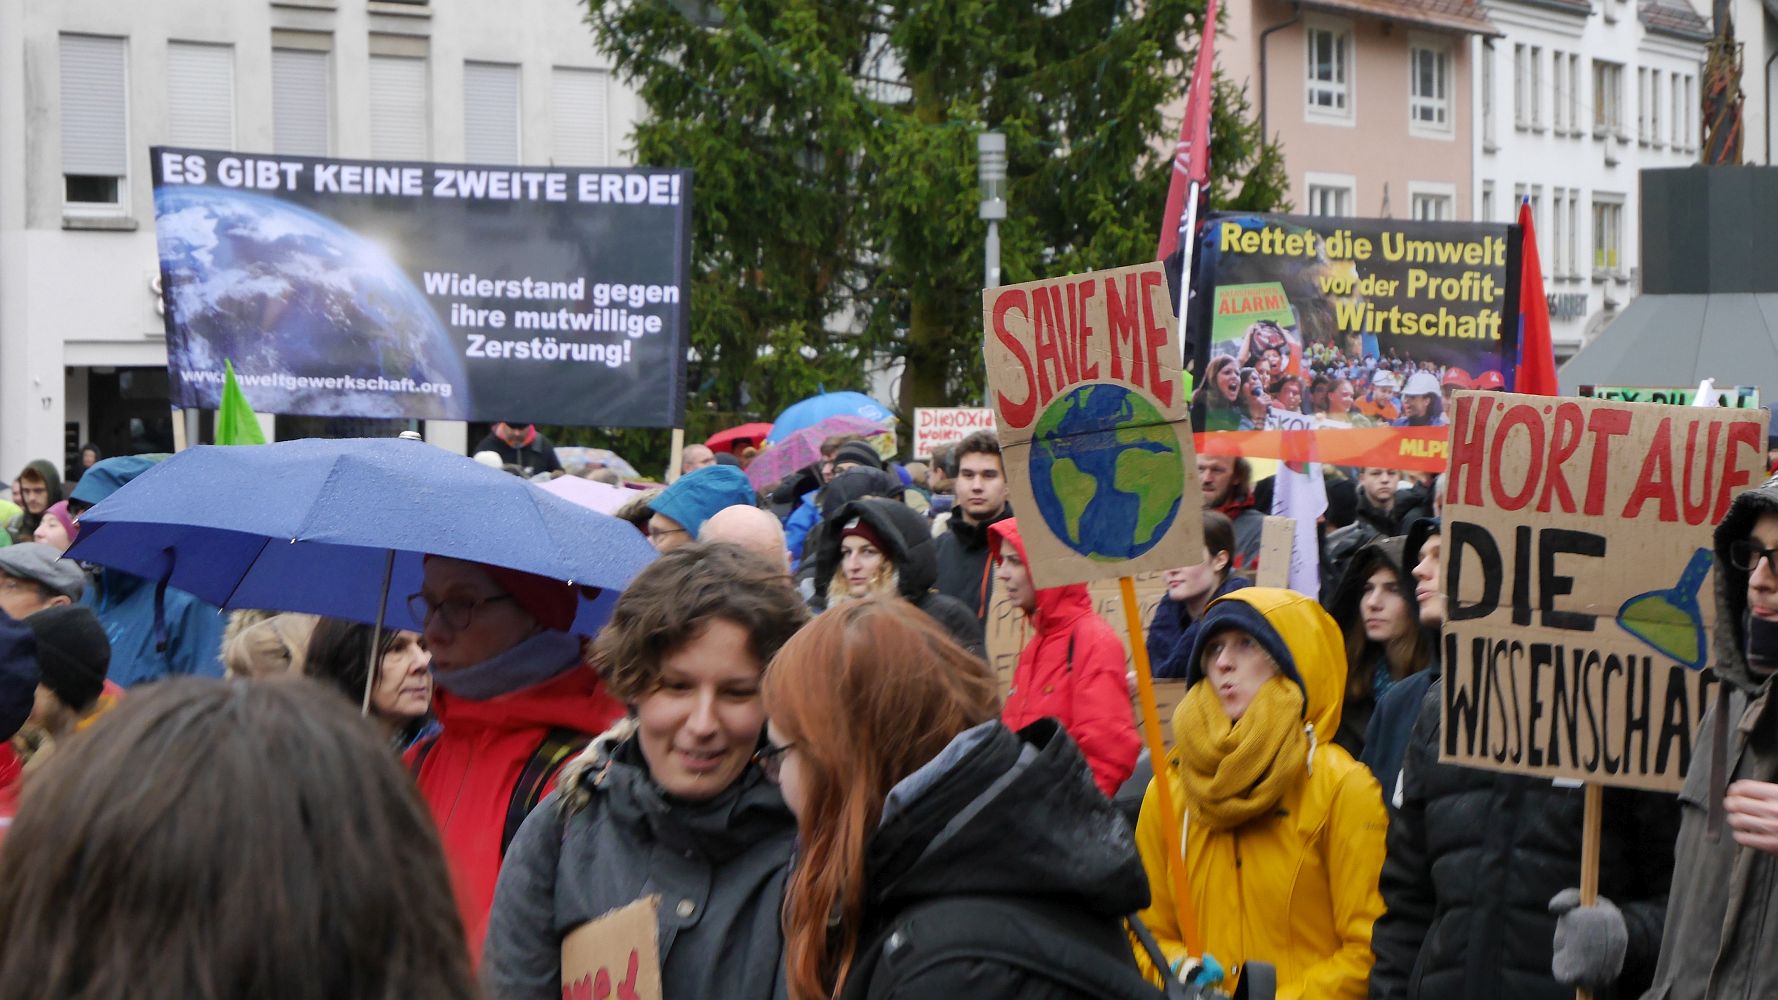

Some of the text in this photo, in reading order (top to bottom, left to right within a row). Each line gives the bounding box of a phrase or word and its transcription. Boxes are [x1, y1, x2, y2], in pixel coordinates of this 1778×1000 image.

[161, 153, 681, 206] ES GIBT KEINE ZWEITE ERDE!
[1220, 222, 1506, 267] Rettet die Umwelt
[423, 270, 680, 307] Widerstand gegen
[1218, 295, 1286, 315] ALARM!
[1320, 268, 1505, 303] vor der Profit-
[451, 304, 662, 338] ihre mutwillige
[1335, 301, 1502, 341] Wirtschaft
[465, 334, 632, 368] Zerstörung!
[992, 271, 1174, 429] SAVE ME
[1446, 395, 1763, 527] HÖRT AUF
[1446, 521, 1607, 632] DIE
[1445, 633, 1720, 778] WISSENSCHA
